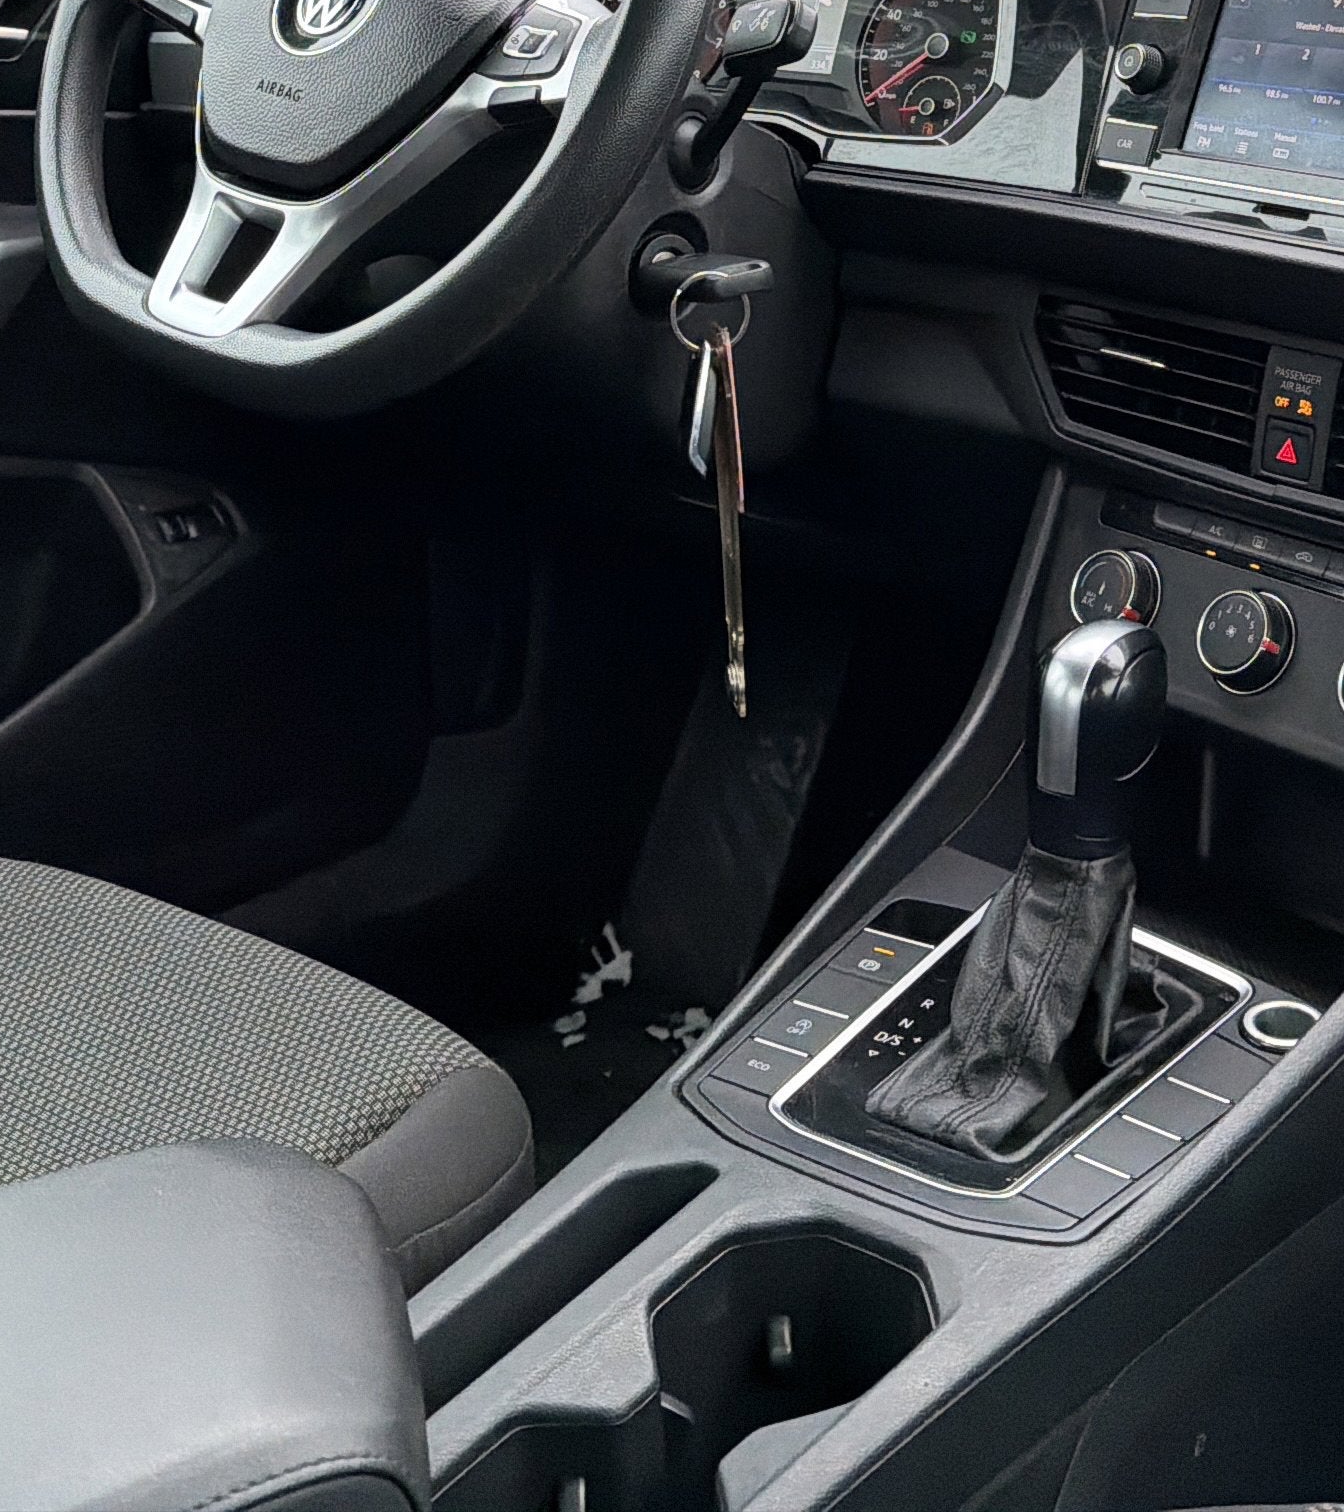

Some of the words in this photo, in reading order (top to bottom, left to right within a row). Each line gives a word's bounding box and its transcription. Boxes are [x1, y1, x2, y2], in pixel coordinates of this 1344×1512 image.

[886, 9, 902, 21] 40
[874, 49, 888, 61] 20
[1302, 48, 1310, 61] 2
[255, 78, 304, 102] AIRBAG
[1116, 137, 1133, 149] CAR
[1274, 366, 1322, 386] PASSENGER
[1280, 380, 1295, 390] AIR
[1295, 383, 1313, 396] BAG
[1274, 396, 1290, 408] OFF
[919, 998, 936, 1009] R
[898, 1017, 915, 1029] N
[873, 1031, 904, 1047] D/S
[747, 1058, 771, 1072] ECO
